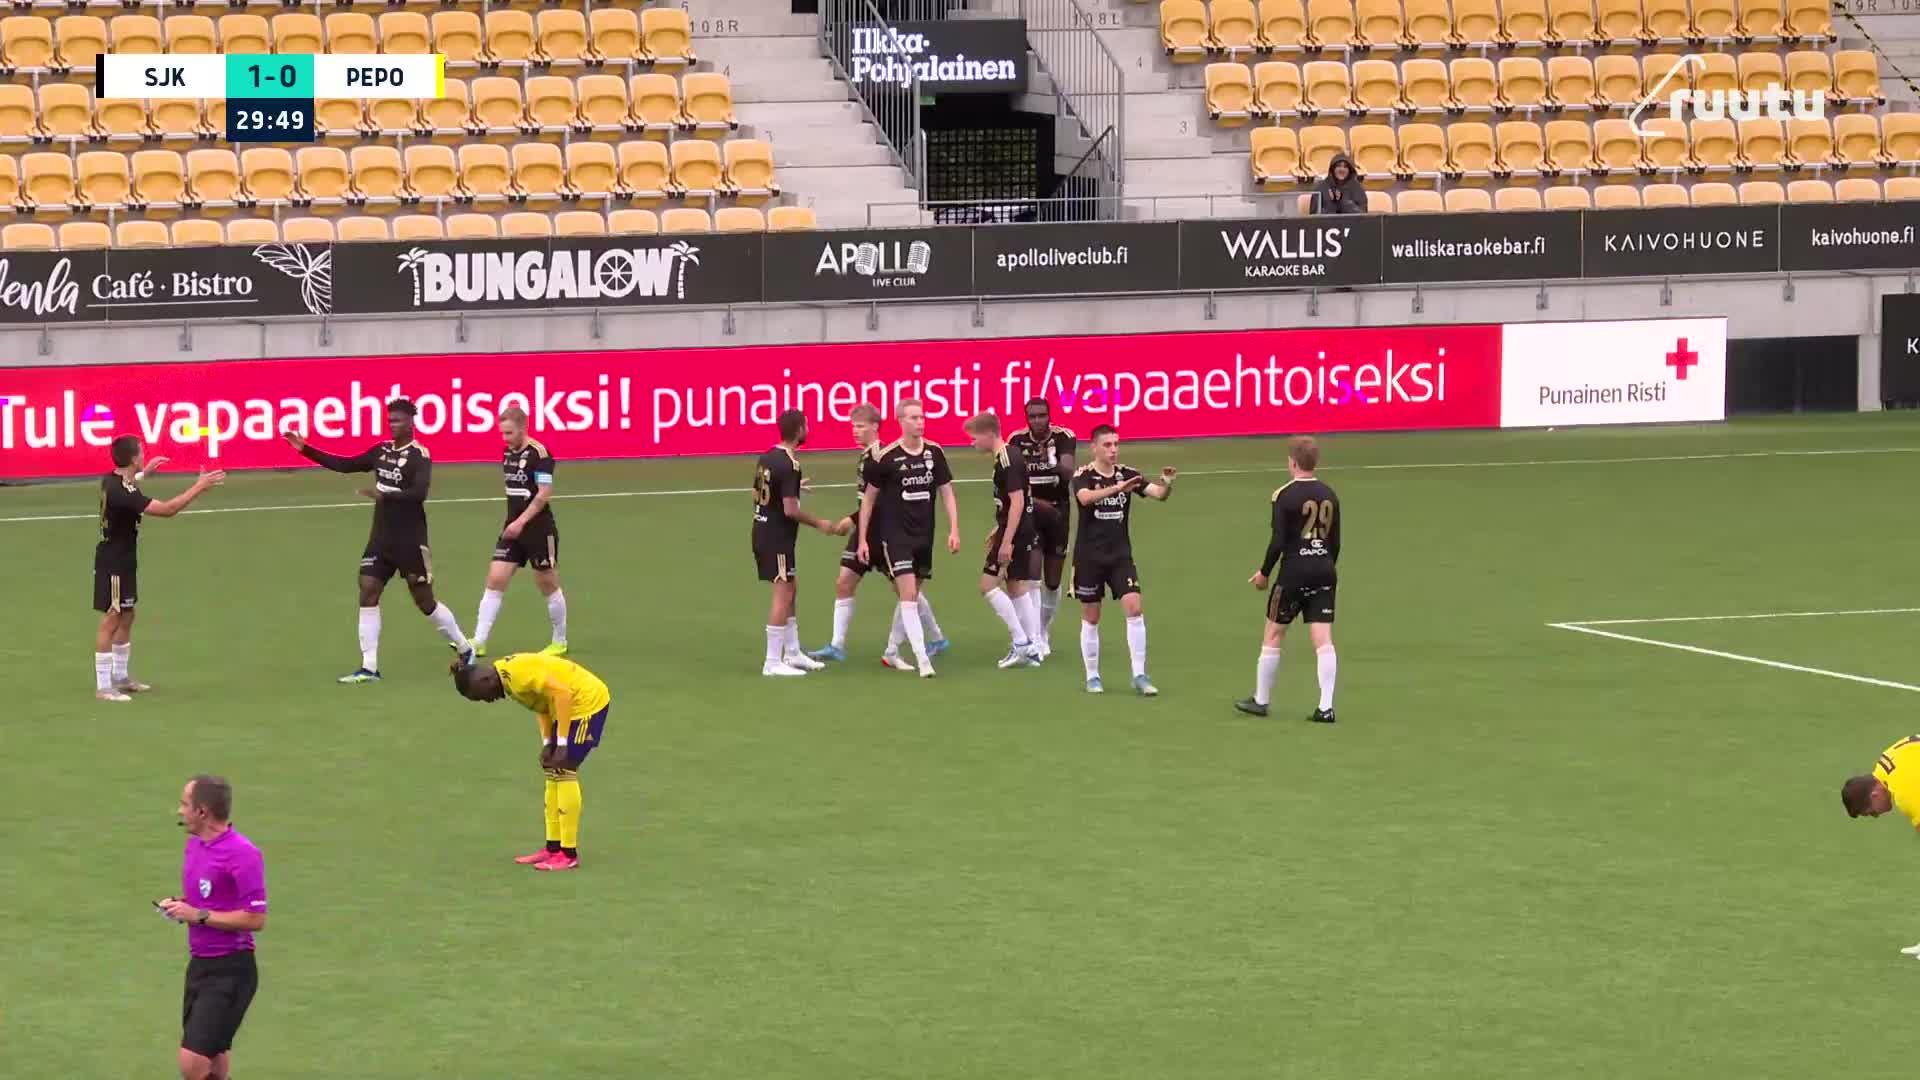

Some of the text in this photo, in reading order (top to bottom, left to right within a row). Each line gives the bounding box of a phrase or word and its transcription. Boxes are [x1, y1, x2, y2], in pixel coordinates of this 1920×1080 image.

[690, 19, 739, 33] 108R
[852, 53, 1017, 88] Pohjalainen
[1391, 236, 1545, 258] walliskaraokebar.fi
[1605, 230, 1764, 252] KAIVOHUONE
[1811, 226, 1914, 246] kaivohuone.fi
[814, 240, 931, 276] APOLLO
[996, 246, 1128, 271] apolloliveclub.fi
[1245, 263, 1325, 277] KARAOKE BAR
[92, 270, 253, 299] Café Bistro
[423, 248, 675, 303] BUNGALOW
[1539, 381, 1667, 405] Punainen Risti
[0, 389, 114, 449] Tule
[1302, 500, 1333, 539] 29
